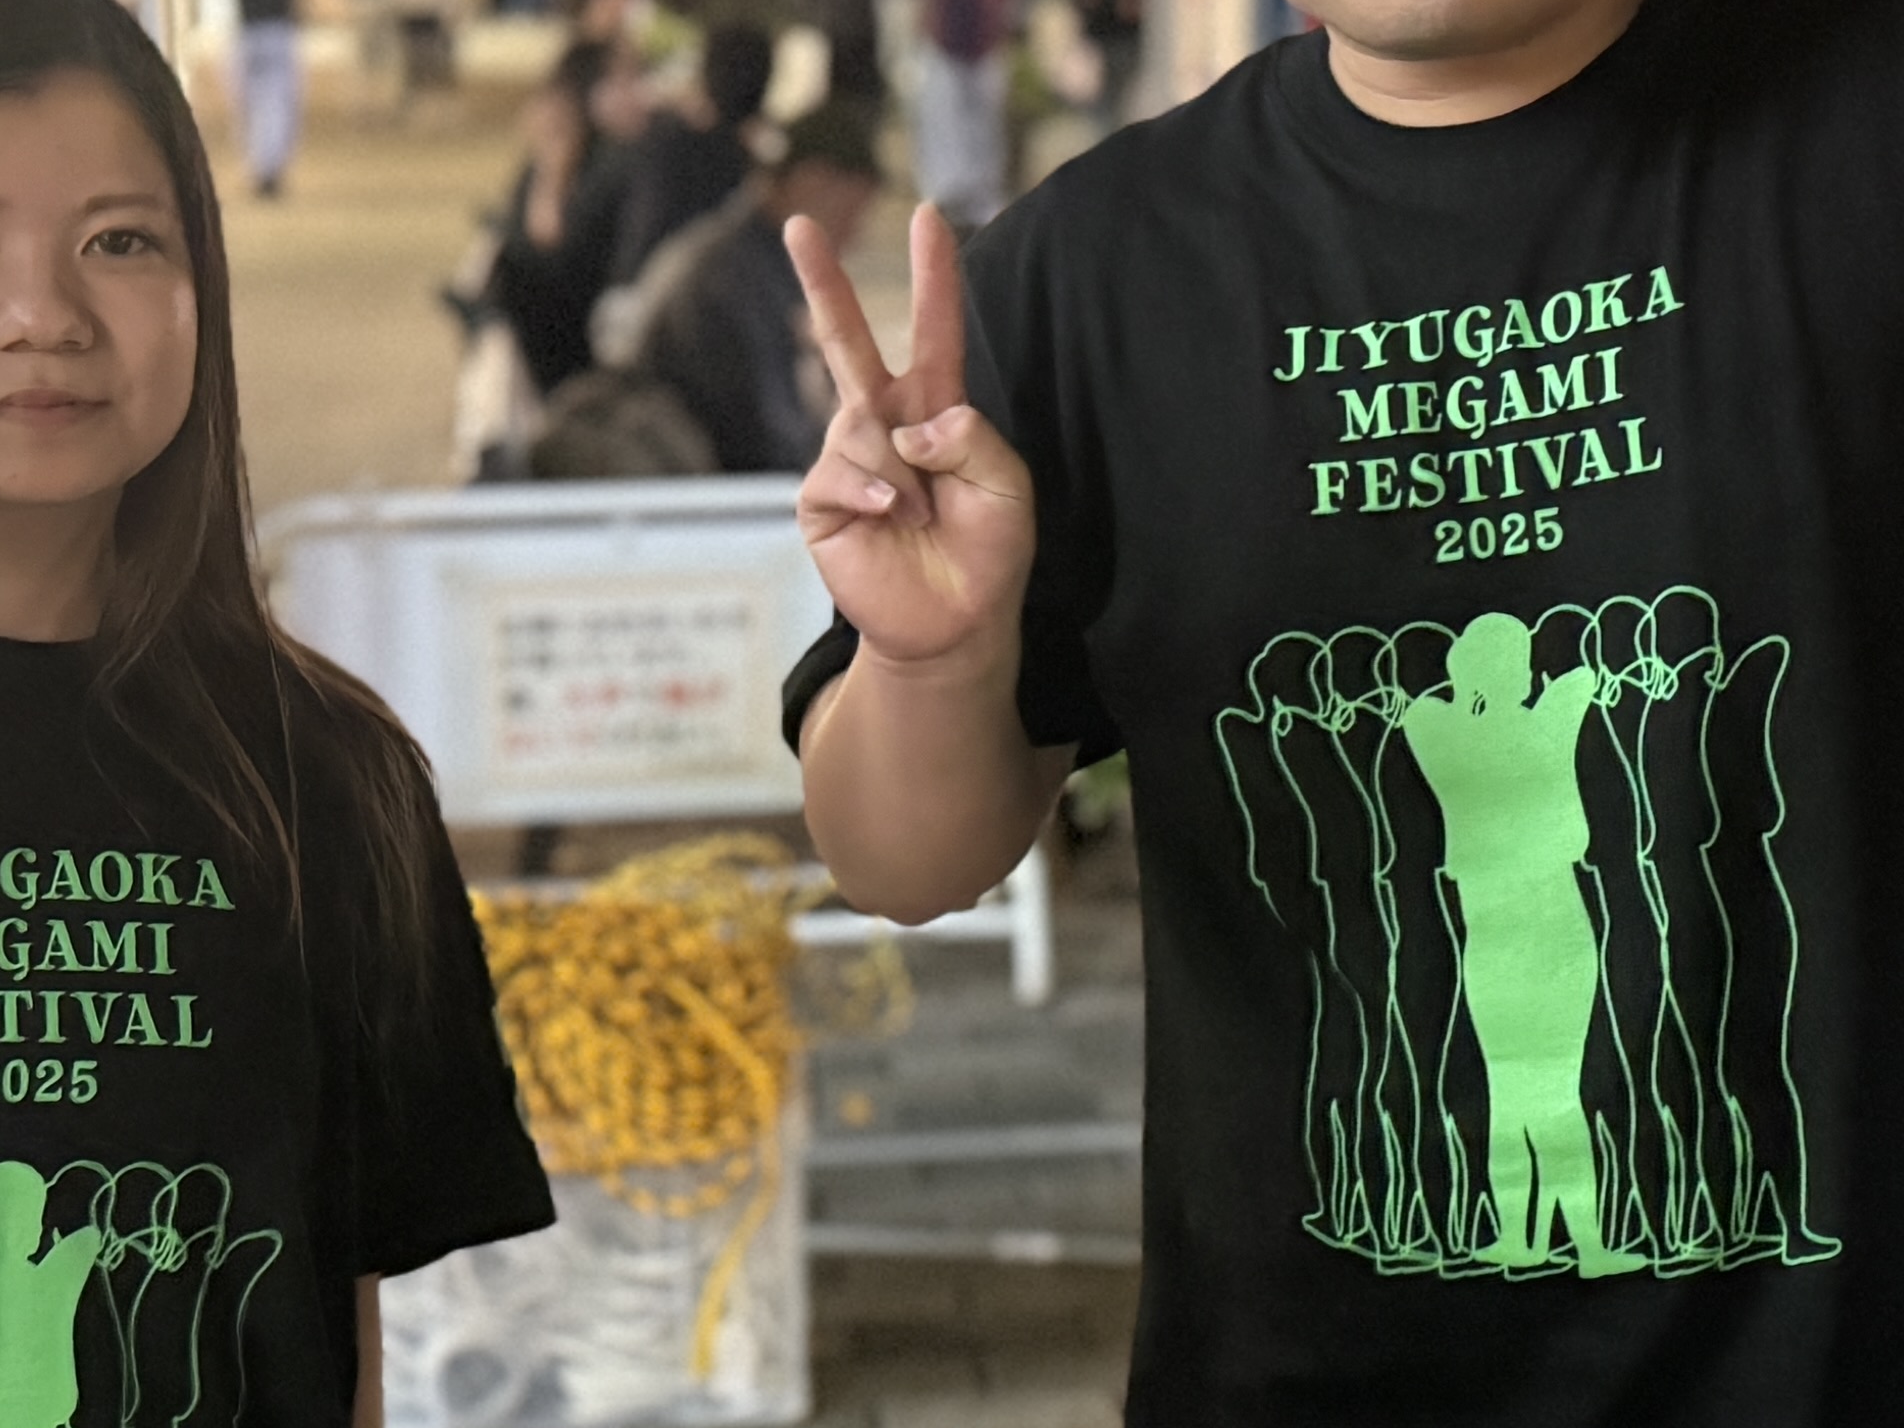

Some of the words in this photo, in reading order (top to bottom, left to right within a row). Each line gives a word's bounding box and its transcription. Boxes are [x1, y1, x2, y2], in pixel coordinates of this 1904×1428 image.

[1273, 264, 1684, 381] JIYUGAOKA
[1337, 346, 1623, 442] MEGAMI
[1308, 416, 1663, 515] FESTIVAL
[1435, 506, 1563, 563] 2025
